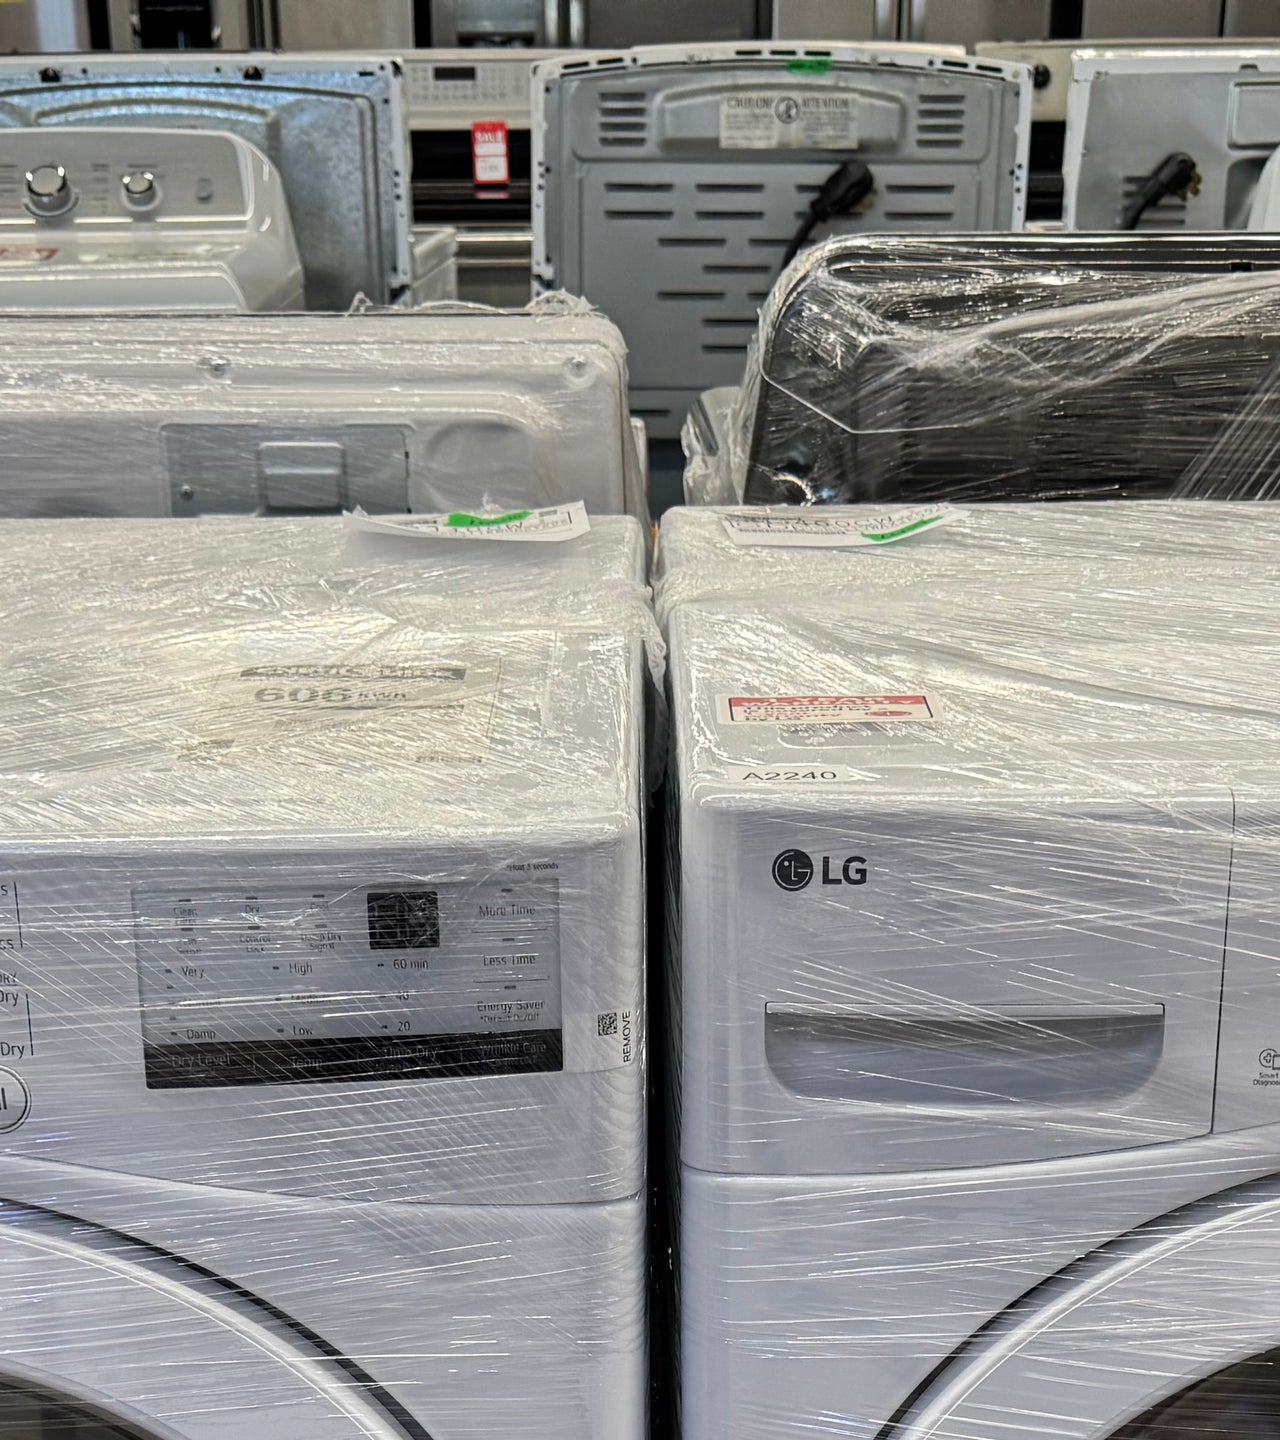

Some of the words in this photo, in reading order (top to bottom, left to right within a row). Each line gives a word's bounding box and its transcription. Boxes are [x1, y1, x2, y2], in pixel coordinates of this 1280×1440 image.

[742, 771, 837, 780] A2240
[533, 862, 559, 870] seconds
[822, 856, 868, 885] LG
[479, 905, 507, 917] More
[511, 904, 536, 915] Time
[393, 958, 407, 970] 60
[411, 958, 429, 970] min
[483, 955, 507, 966] Less
[511, 954, 536, 965] Time
[182, 966, 205, 979] Very
[289, 963, 313, 976] High
[477, 1000, 513, 1014] Energy
[516, 999, 545, 1010] Saver
[293, 1025, 313, 1036] Low
[398, 1021, 411, 1032] 20
[187, 1029, 216, 1042] Damp
[623, 1010, 632, 1063] REMOVE
[0, 1041, 25, 1059] Dry
[523, 1042, 546, 1053] Care
[171, 1054, 194, 1071] Dry
[198, 1052, 231, 1067] Level
